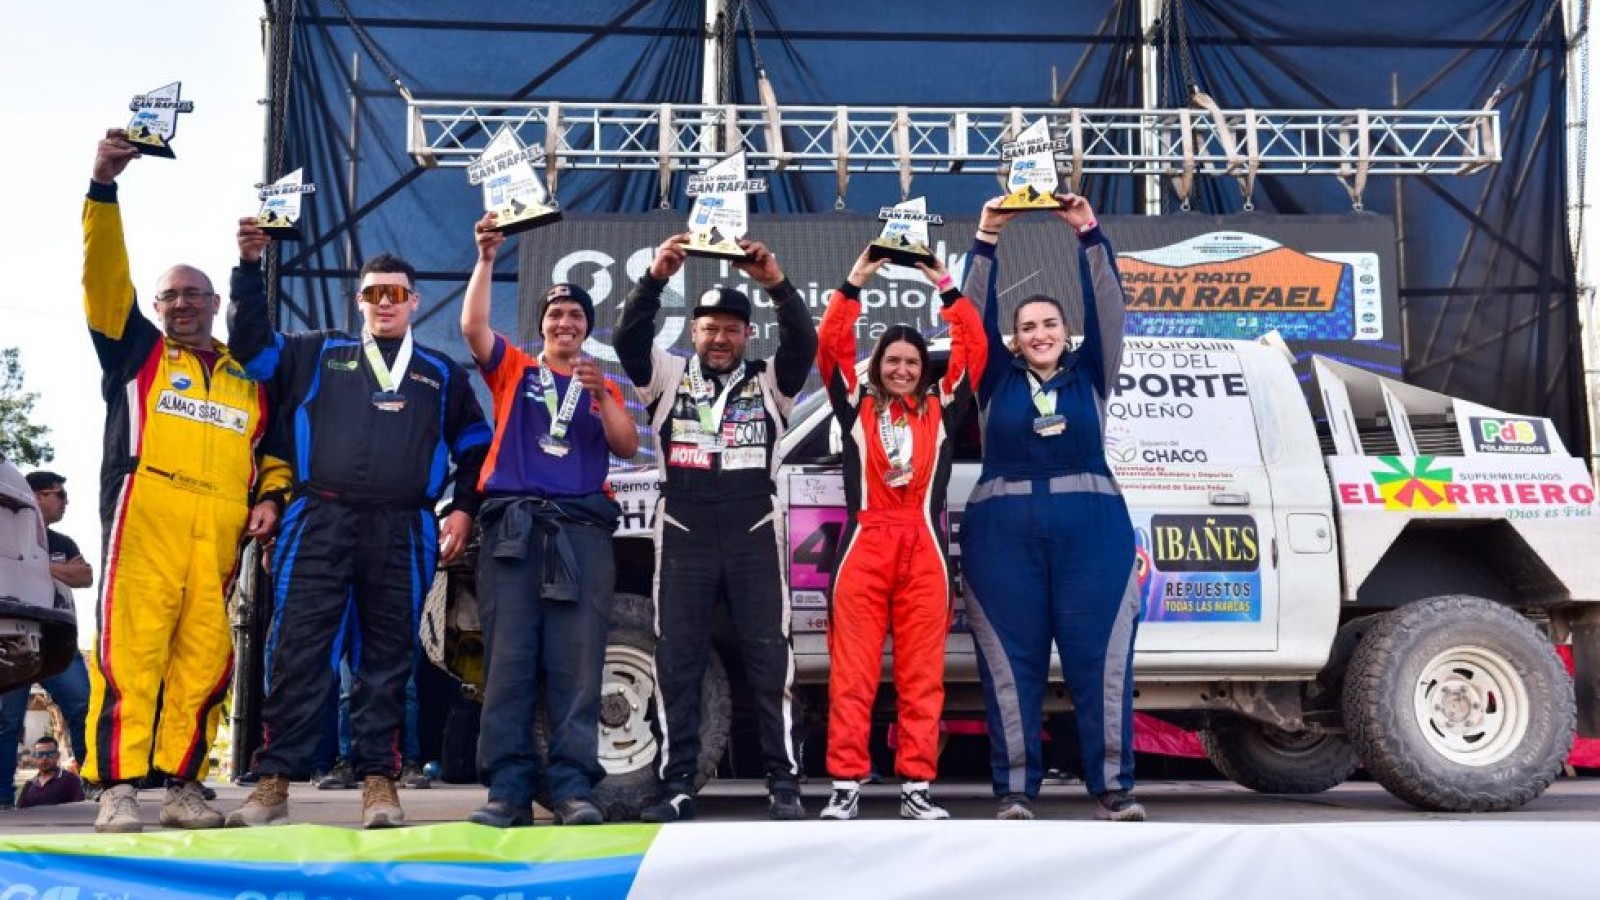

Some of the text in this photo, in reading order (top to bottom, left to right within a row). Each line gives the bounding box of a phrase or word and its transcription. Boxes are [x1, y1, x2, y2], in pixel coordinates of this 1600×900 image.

[471, 145, 542, 182] SAN RAFAEL
[688, 180, 764, 193] SAN RAFAEL
[1119, 271, 1251, 284] RALLY RAID
[1122, 287, 1325, 308] SAN RAFAEL
[1174, 353, 1218, 369] DEL
[1114, 373, 1248, 398] PORTE
[158, 394, 196, 417] ALMAQ
[1107, 403, 1194, 420] QUEÑO
[1482, 420, 1536, 444] PdS
[671, 447, 710, 464] MOTUL
[1142, 449, 1209, 463] CHACO
[1479, 444, 1546, 454] POLARIZADOS
[1459, 472, 1563, 481] SUPERMERCADOS
[1339, 483, 1387, 504] EL
[1505, 504, 1592, 520] Dios es Fiel
[1155, 517, 1258, 561] IBAÑES
[1165, 582, 1251, 597] REPUESTOS
[1165, 600, 1250, 612] TODAS LAS MARCAS
